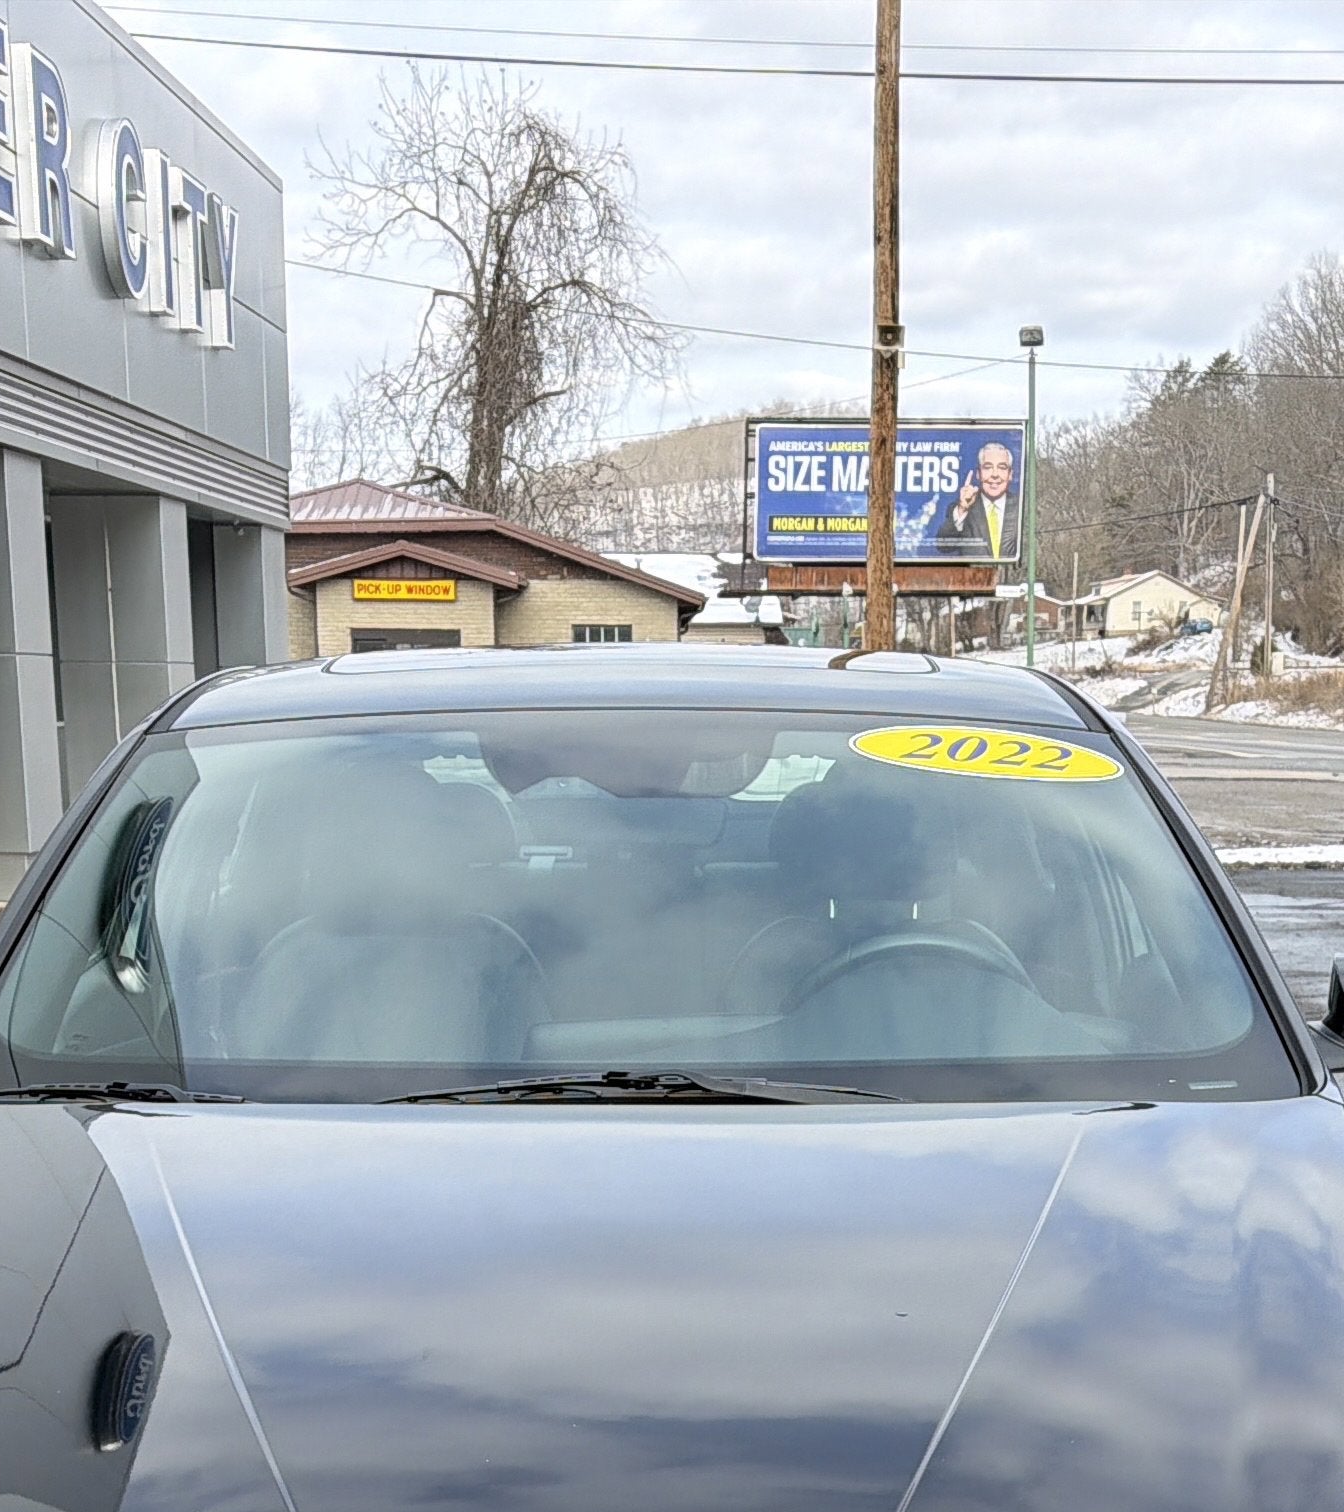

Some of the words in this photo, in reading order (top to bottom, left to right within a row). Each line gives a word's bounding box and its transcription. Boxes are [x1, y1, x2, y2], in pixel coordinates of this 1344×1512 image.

[99, 116, 239, 350] CITY
[768, 440, 824, 452] AMERICA'S
[825, 441, 871, 453] LARGEST
[909, 441, 933, 453] LAW
[767, 454, 827, 492] SIZE
[831, 454, 960, 493] MATERS
[772, 517, 816, 532] MORGAN
[817, 517, 825, 532] &
[826, 517, 869, 532] MORGAN
[356, 583, 402, 595] PICK-UP
[404, 584, 452, 596] WINDOW
[899, 733, 1073, 771] 2022
